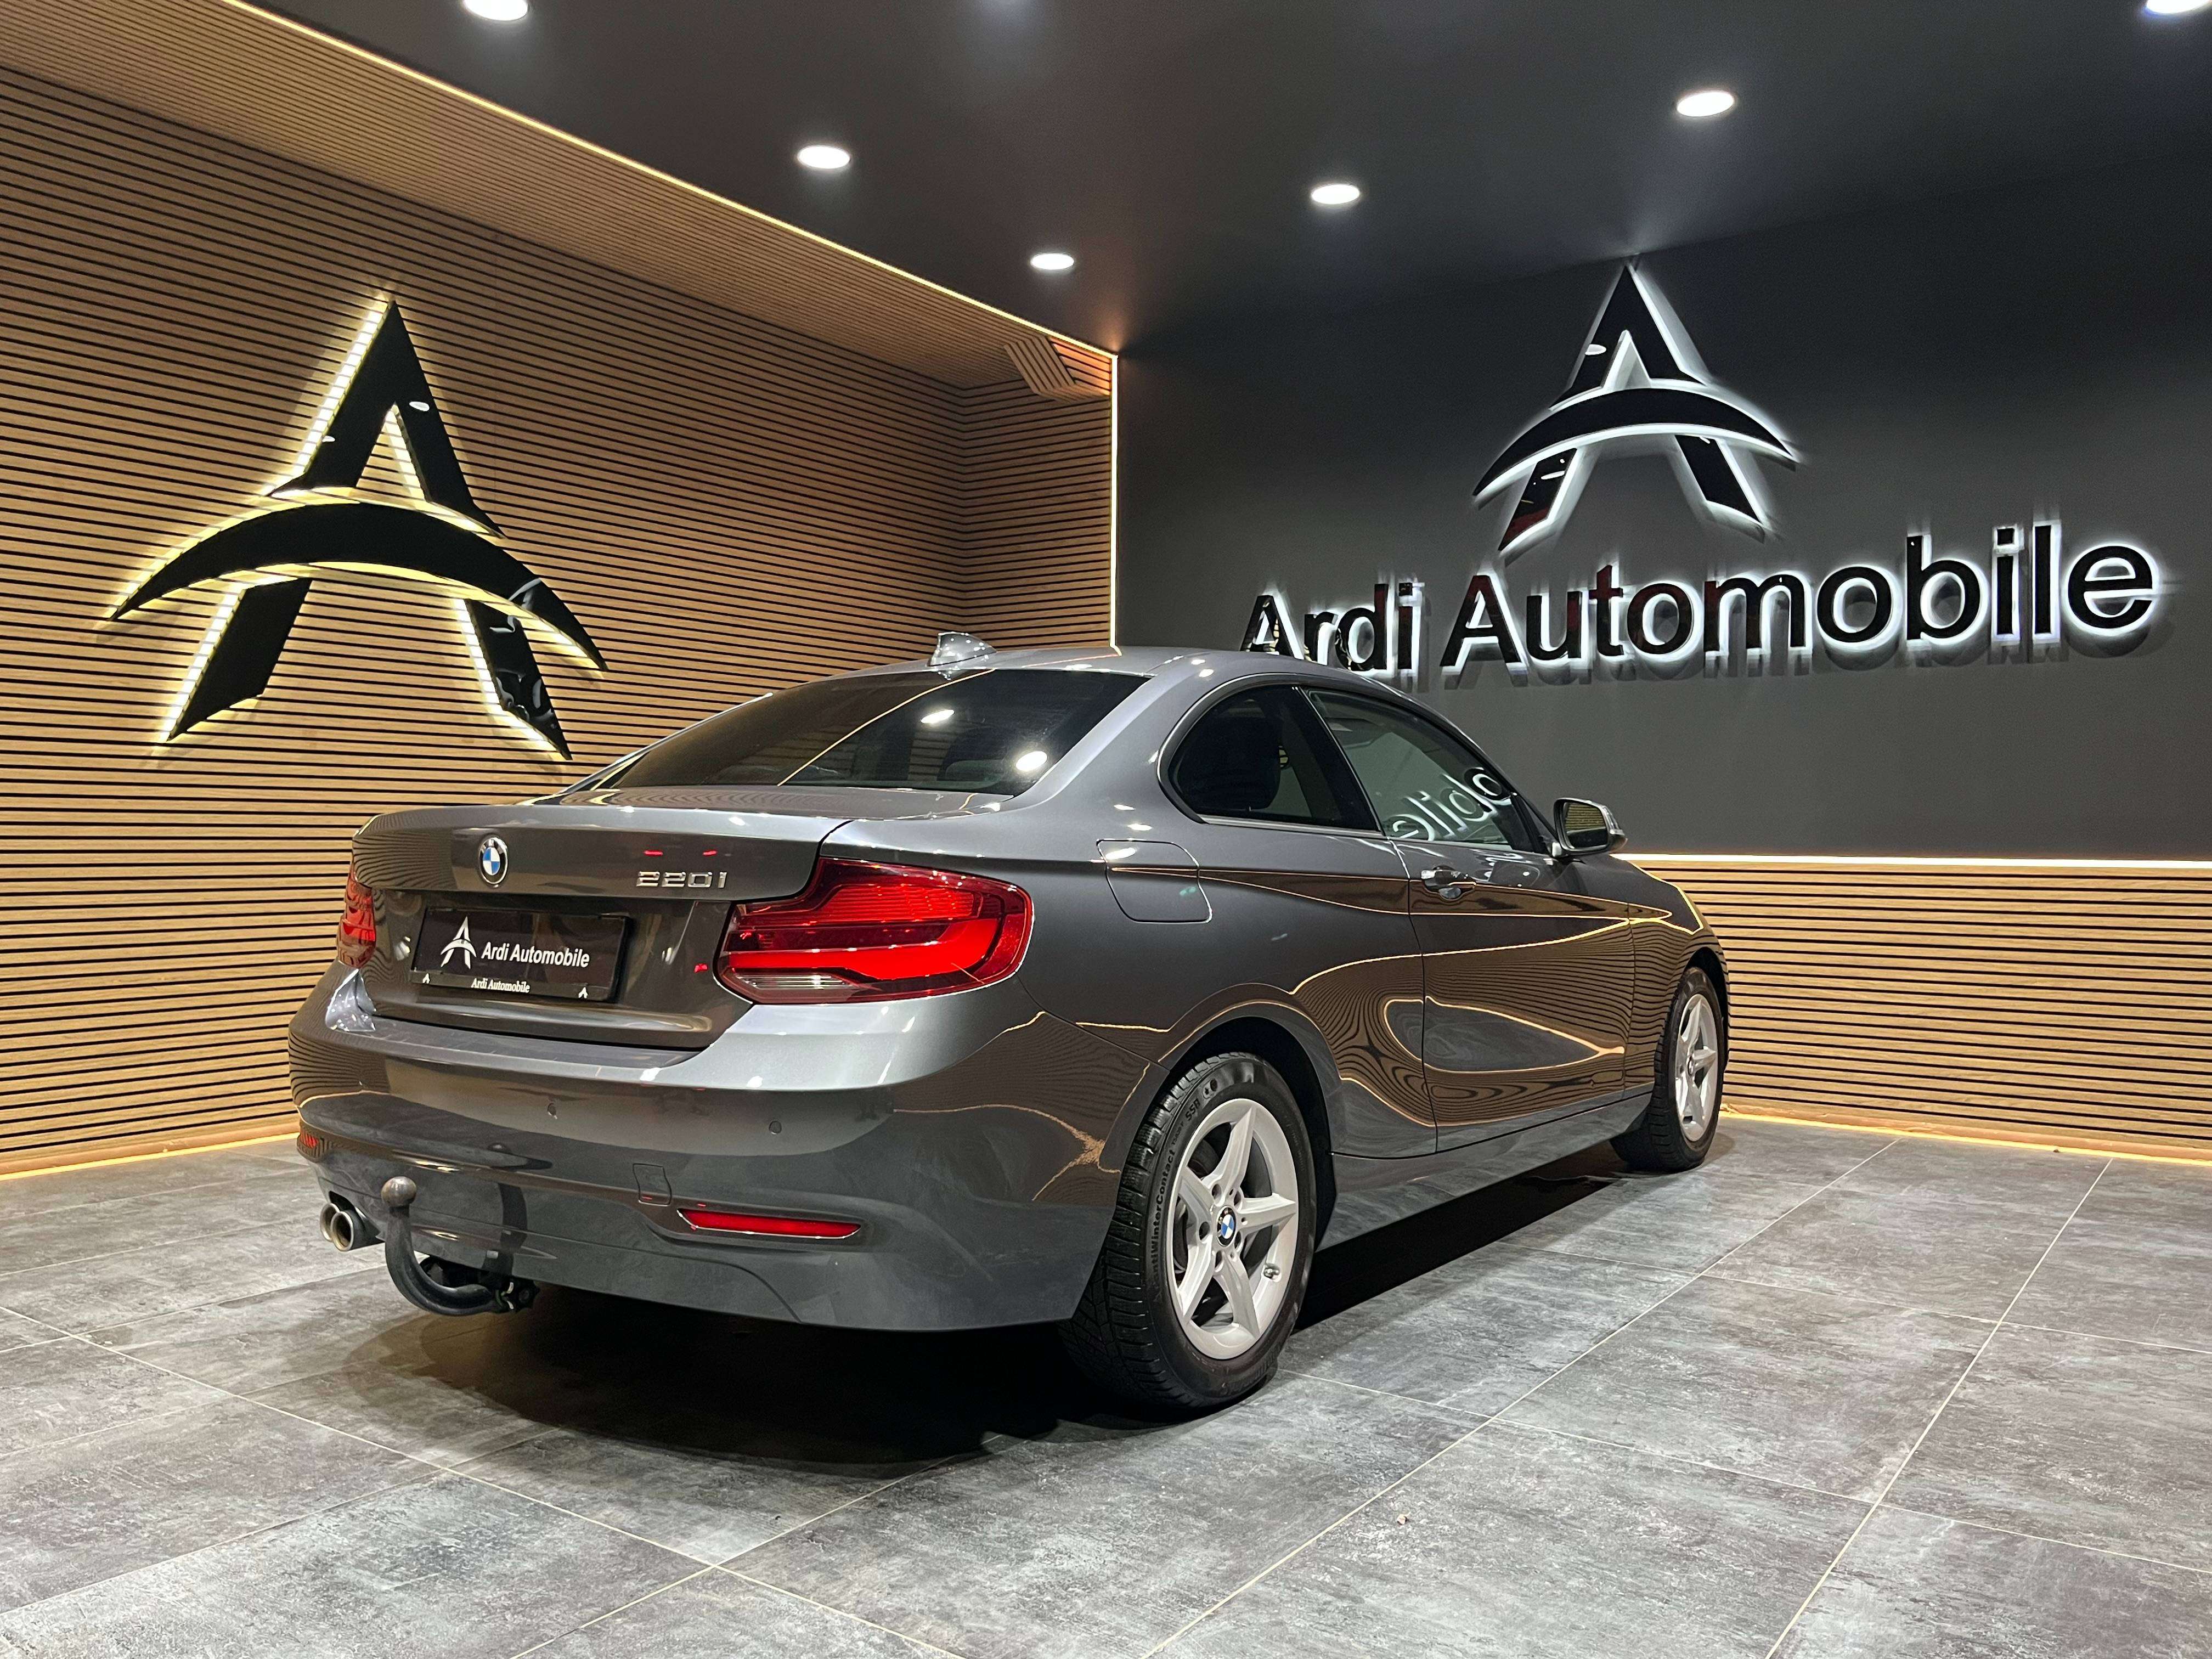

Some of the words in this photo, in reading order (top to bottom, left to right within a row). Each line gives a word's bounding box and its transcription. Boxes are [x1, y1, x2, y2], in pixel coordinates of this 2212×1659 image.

[1239, 582, 1414, 673] Ardi
[1439, 524, 2154, 667] Automobile
[481, 941, 510, 961] Ardi
[510, 943, 590, 968] Automobile
[471, 977, 488, 989] Ardi
[488, 978, 531, 994] Automobile
